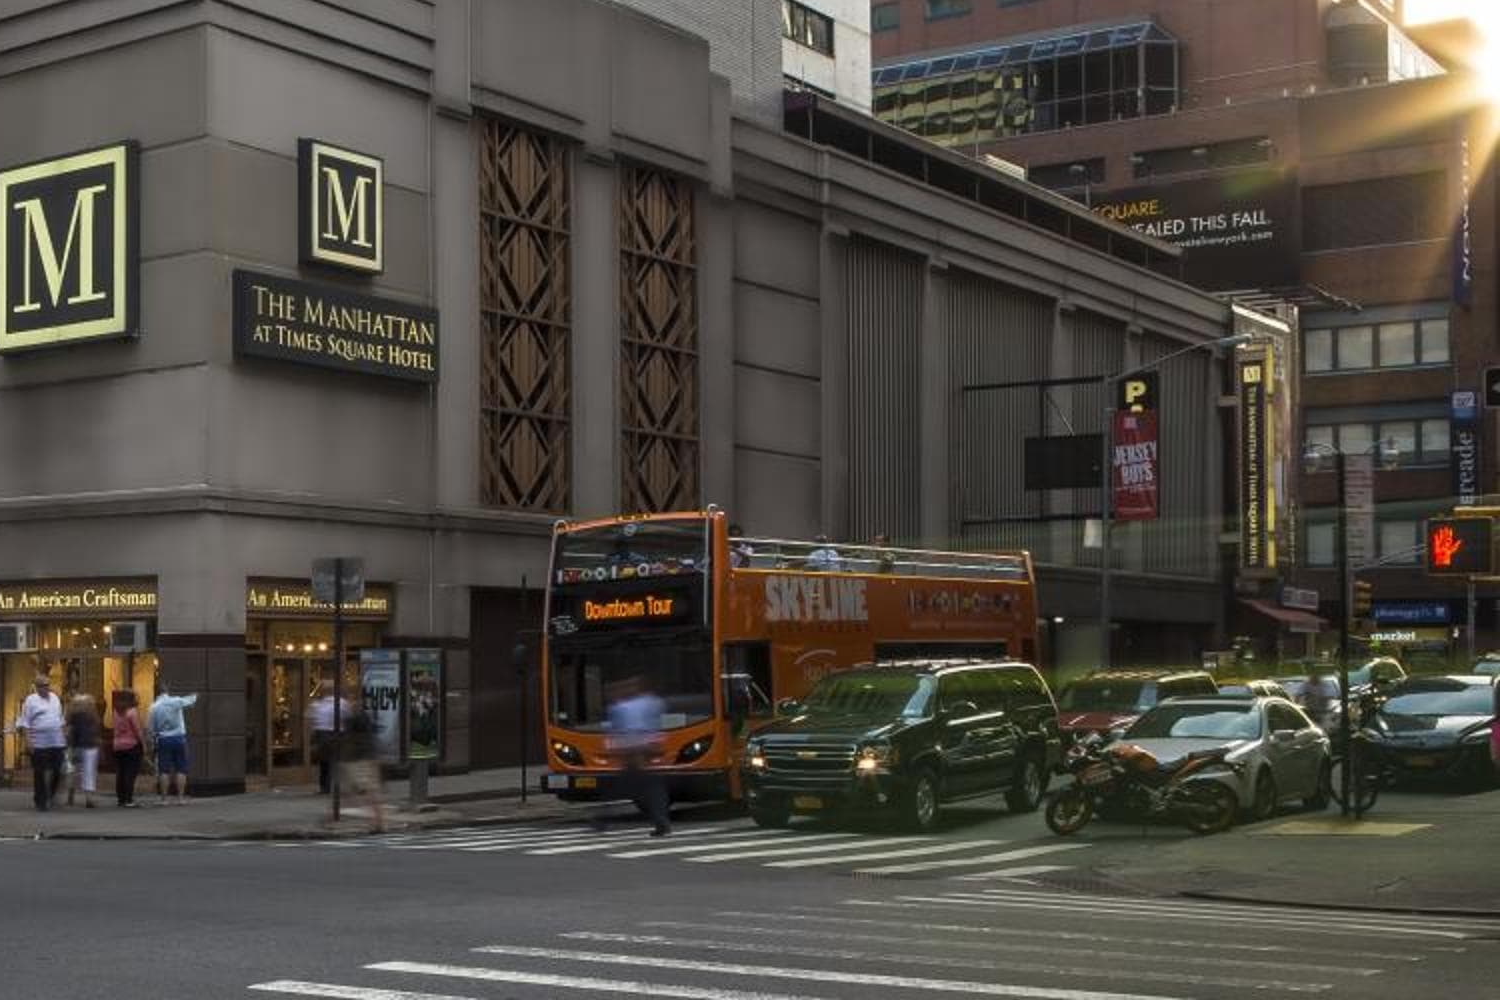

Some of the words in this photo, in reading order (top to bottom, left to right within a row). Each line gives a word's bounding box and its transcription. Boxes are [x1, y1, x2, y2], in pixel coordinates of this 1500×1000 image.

[322, 166, 373, 247] M
[1190, 213, 1227, 231] THIS
[13, 184, 106, 312] M
[252, 285, 297, 321] THE
[304, 296, 435, 345] MANHATTAN
[253, 325, 272, 343] AT
[276, 325, 322, 353] TIMES
[328, 333, 384, 361] SQUARE
[388, 345, 434, 371] HOTEL
[1126, 381, 1147, 403] P
[19, 591, 81, 608] American
[83, 588, 156, 607] Craftsman
[248, 589, 267, 607] An
[585, 600, 645, 620] Downtown
[646, 596, 673, 615] Tour
[765, 576, 869, 621] SKYLINE
[1370, 630, 1416, 641] market
